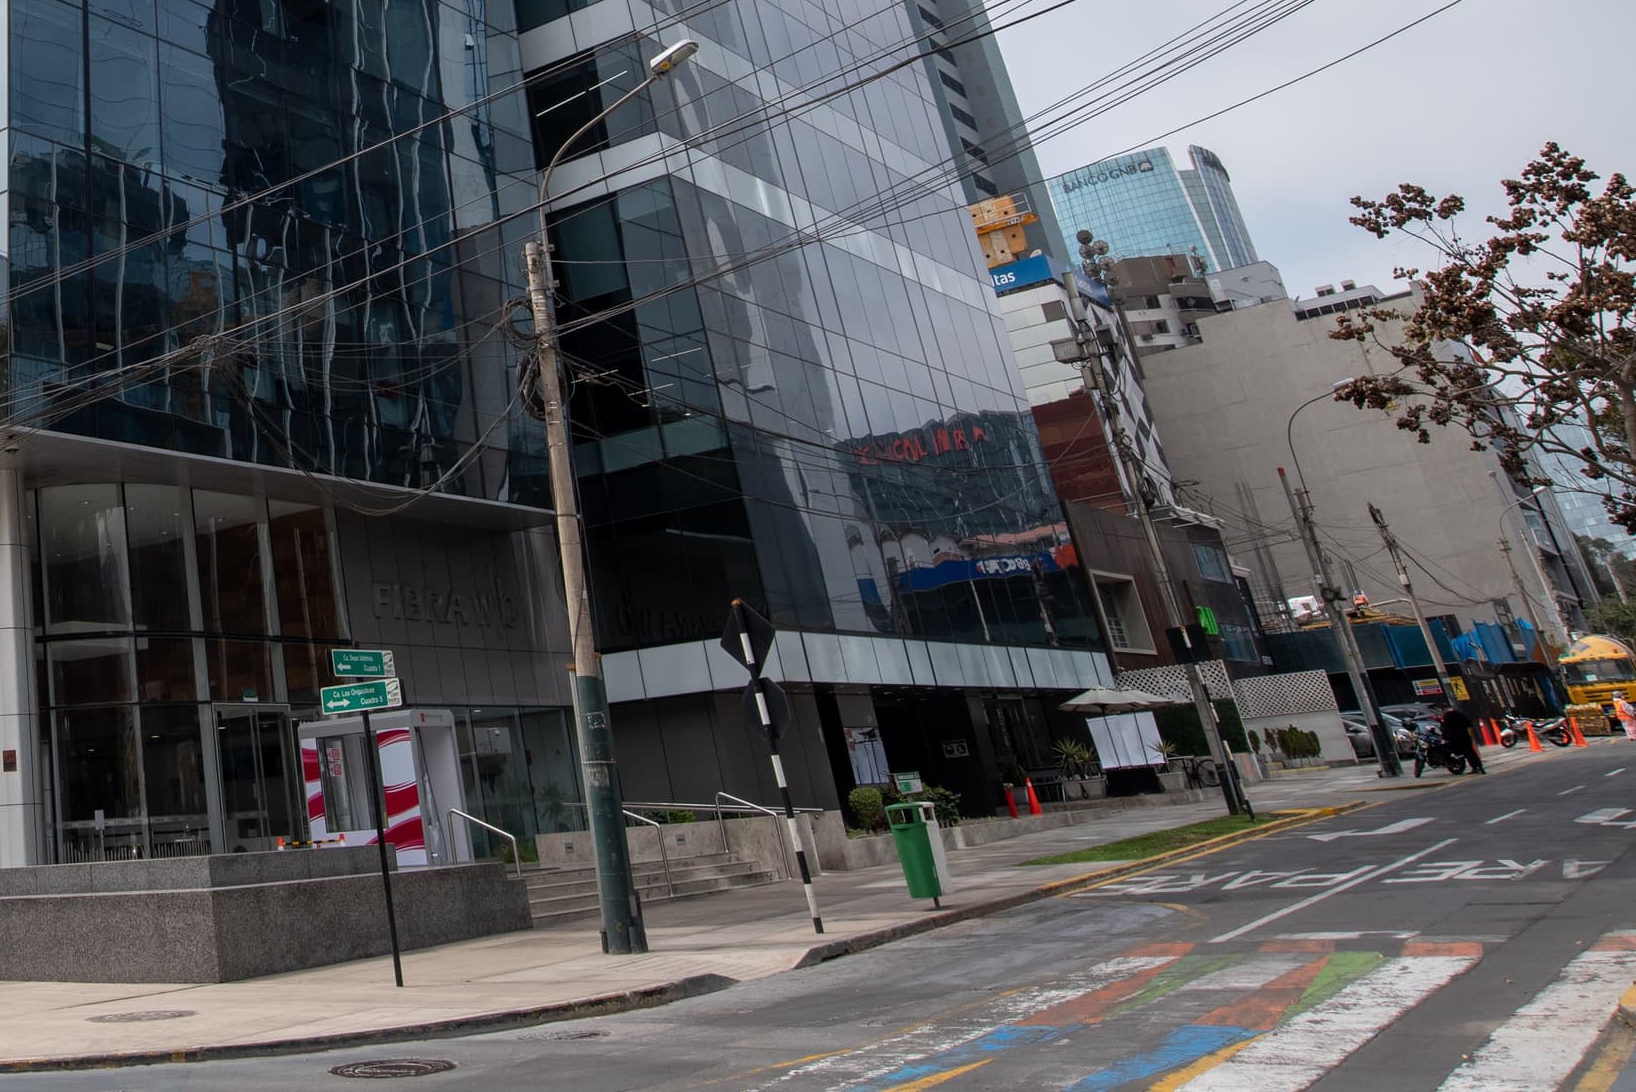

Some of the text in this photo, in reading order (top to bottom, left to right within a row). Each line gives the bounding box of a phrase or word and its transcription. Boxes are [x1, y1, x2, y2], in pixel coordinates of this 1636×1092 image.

[1063, 164, 1137, 194] BANCO GNB
[372, 581, 468, 626] FIBRA
